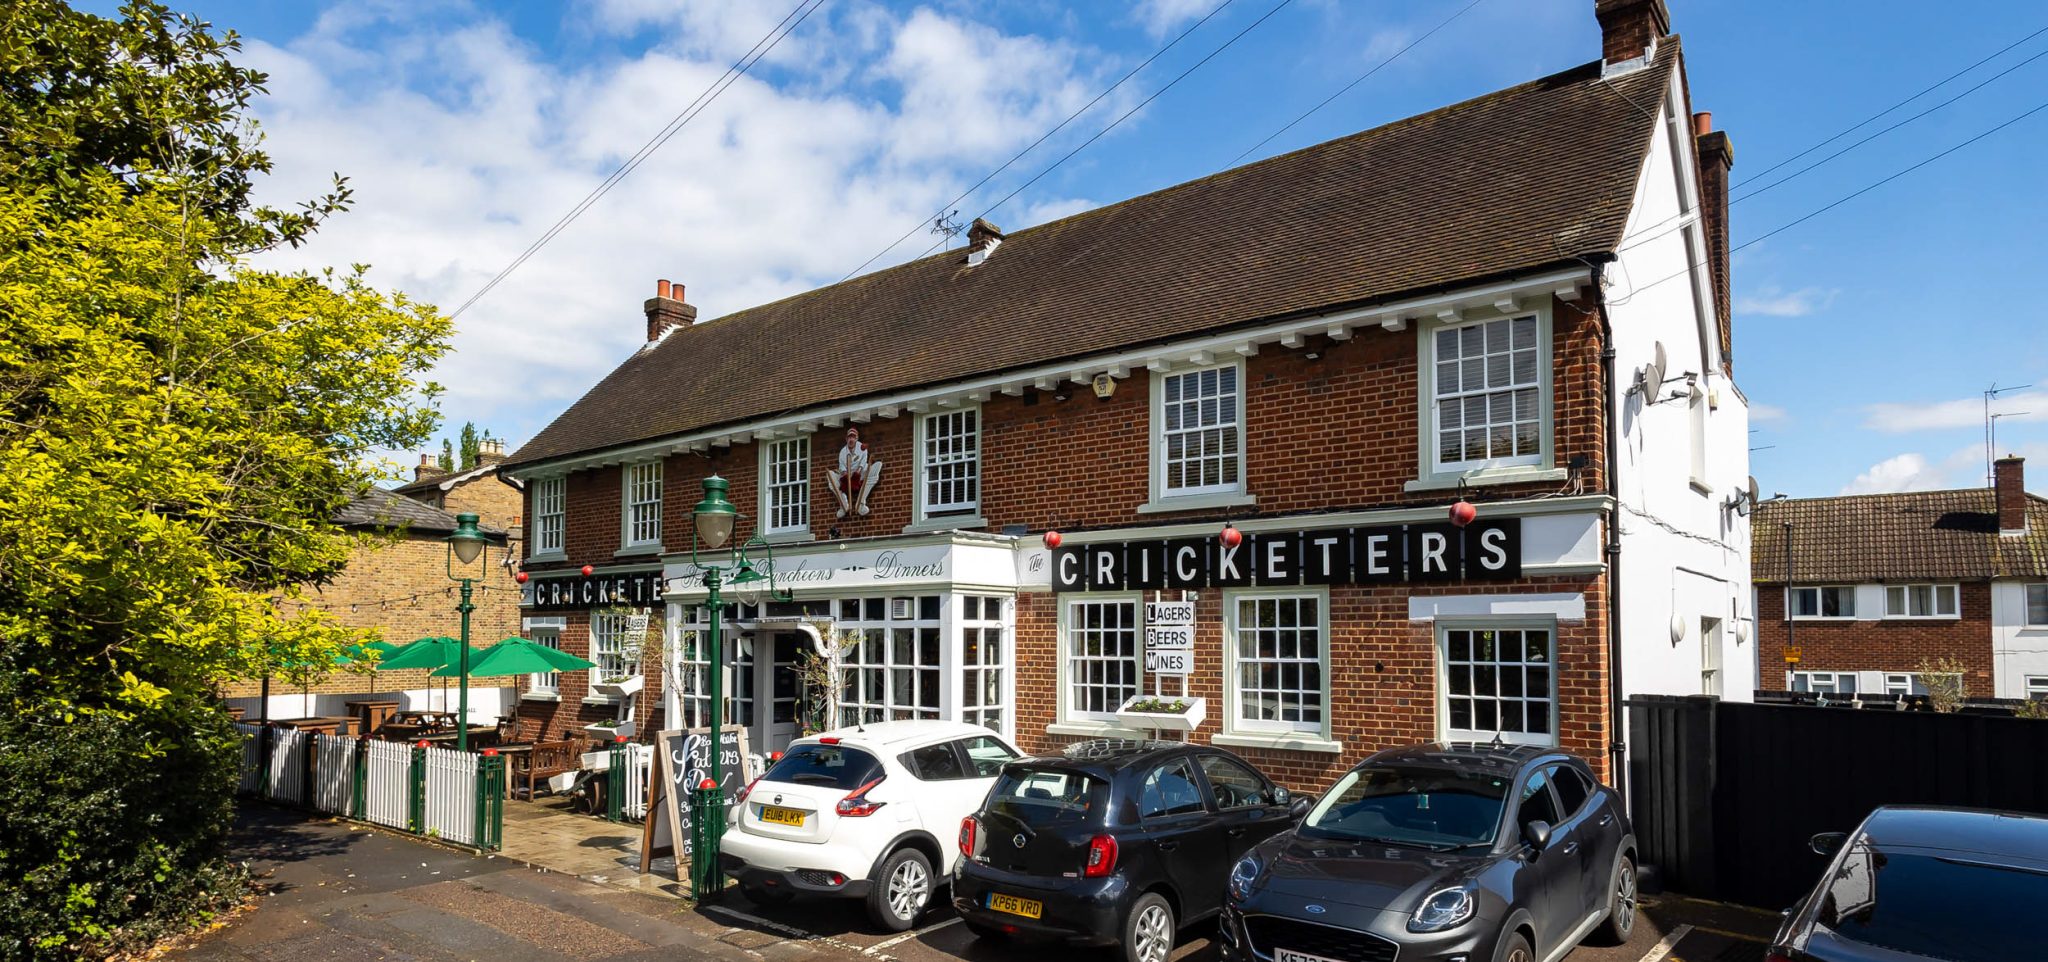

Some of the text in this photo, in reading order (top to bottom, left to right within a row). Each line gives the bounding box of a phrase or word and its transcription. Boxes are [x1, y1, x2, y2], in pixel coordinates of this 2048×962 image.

[873, 550, 943, 580] Dinners
[1029, 528, 1508, 586] The CRICKETERS
[536, 577, 662, 606] CRICKETE
[1147, 605, 1191, 622] LAGERS
[1147, 630, 1186, 647] BEERS
[1147, 652, 1184, 670] WINES
[993, 894, 1040, 915] KP66 VRD
